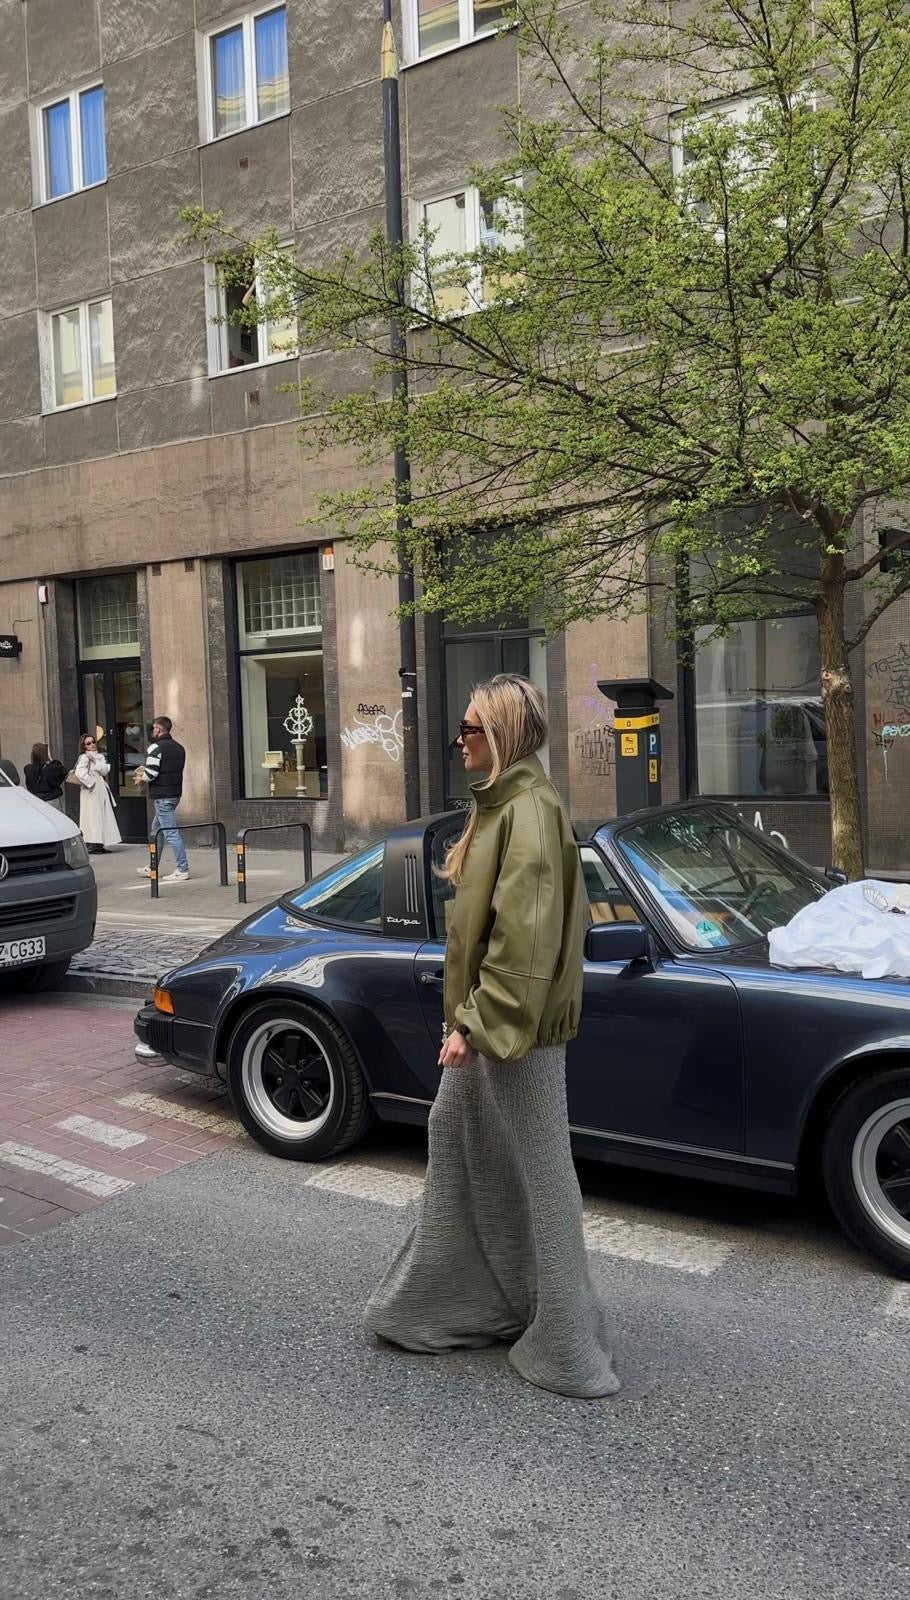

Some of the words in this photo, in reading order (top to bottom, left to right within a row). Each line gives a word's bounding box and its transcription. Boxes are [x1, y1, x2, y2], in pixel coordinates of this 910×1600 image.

[649, 734, 657, 752] P
[386, 916, 421, 926] targa
[10, 938, 44, 959] CG33
